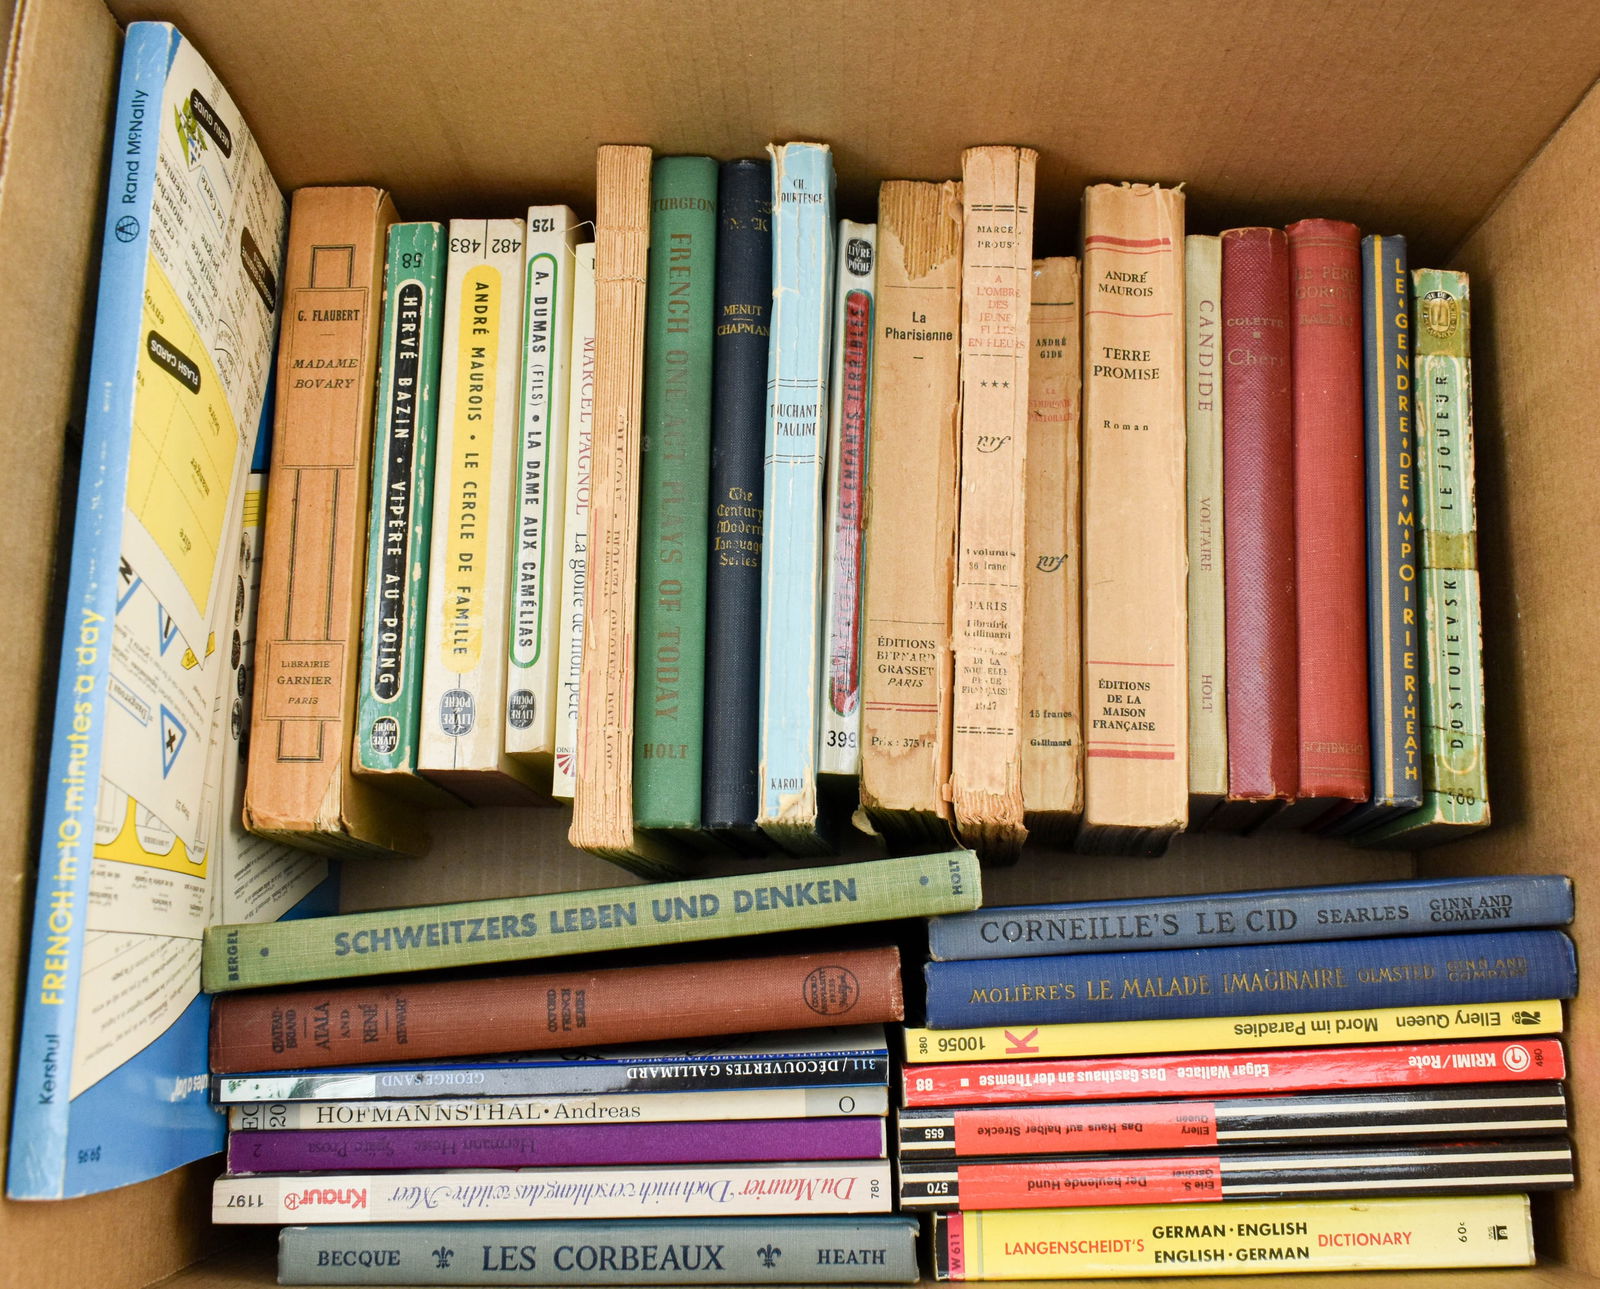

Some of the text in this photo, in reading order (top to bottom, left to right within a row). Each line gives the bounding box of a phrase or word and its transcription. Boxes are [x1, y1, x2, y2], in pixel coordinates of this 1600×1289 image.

[122, 89, 150, 205] Rand McNally
[533, 218, 556, 232] 125
[450, 238, 482, 253] 483
[491, 238, 522, 253] 482
[402, 252, 424, 269] 58
[1105, 270, 1148, 284] ANDRÉ
[1098, 283, 1154, 297] MAUROIS
[298, 309, 360, 323] G. FLAUBERT
[723, 304, 763, 317] MENUT
[912, 311, 927, 324] La
[717, 324, 770, 337] CHAPMAN
[1227, 316, 1285, 329] COLETTE
[885, 327, 953, 342] Pharisienne
[1035, 336, 1067, 347] ANDRÉ
[150, 338, 199, 386] FLASH CARDS
[1040, 350, 1063, 360] GIDE
[1102, 346, 1151, 362] TERRE
[1198, 299, 1215, 412] CANDIDE
[292, 358, 358, 370] MADAME
[1093, 365, 1160, 381] PROMISE
[293, 378, 355, 390] BOVARY
[1104, 420, 1149, 432] Roman
[1435, 376, 1451, 473] JOUEUR
[452, 281, 490, 655] ANDRÉ MAUROIS LE CERCLE DE FAMILLE
[518, 271, 550, 648] A. DUMAS (FILS) LA DAME AUX CAMÉLIAS
[653, 233, 692, 720] FRENCH ONE-ACT PLAYS OF TODAY
[379, 296, 419, 684] HERVÉ BAZIN VIPÈRE AU POING
[1440, 486, 1453, 511] LE
[1394, 257, 1418, 780] LE GENDRE DE M POIRIER HEATH
[1199, 497, 1212, 572] VOLTAIRE
[77, 608, 106, 667] day
[877, 635, 936, 650] ÉDITIONS
[281, 659, 330, 669] LIBRAIRIE
[878, 664, 935, 677] GRASSET
[76, 674, 94, 692] a
[277, 674, 332, 686] GARNIER
[887, 677, 924, 688] PARIS
[1098, 677, 1151, 691] ÉDITIONS
[287, 697, 319, 705] PARIS
[1107, 694, 1142, 705] DE LA
[1201, 674, 1213, 713] HOLT
[1103, 706, 1146, 718] MAISON
[1092, 718, 1156, 733] FRANÇAISE
[62, 700, 94, 812] minutes
[642, 743, 689, 760] HOLT
[53, 857, 77, 882] in
[948, 859, 961, 895] HOLT
[1429, 895, 1513, 911] GINN AND
[334, 877, 857, 956] SCHWEITZERS LEBEN UND DENKEN
[1430, 907, 1514, 923] COMPANY
[980, 905, 1409, 944] CORNEILLE'S LE CID SEARLES
[41, 891, 75, 1005] FRENCH
[228, 929, 239, 982] BERGEL
[968, 963, 1435, 1004] MOLIÈRE'S LE MALADE IMAGINAIRE OLMSTED
[546, 989, 557, 1033] OXFORD
[561, 988, 572, 1033] FRENCH
[313, 1001, 331, 1051] ATALA
[340, 1009, 351, 1038] AND
[359, 1003, 378, 1044] RENÉ
[1234, 1011, 1501, 1038] Ellery Queen Mord im Paradies
[918, 1036, 928, 1055] 380
[938, 1036, 987, 1052] 10056
[38, 1034, 60, 1105] Kershul
[626, 1058, 876, 1080] 311 DÉCOUVERTES GALLIMARD
[979, 1063, 1269, 1088] Edgar Wallace Das Gasthaus an der Themse
[382, 1071, 485, 1087] GEORGE SAND
[916, 1078, 934, 1091] 88
[316, 1101, 641, 1124] HOFMANNSTHAL Andreas
[1175, 1114, 1209, 1125] Queen
[924, 1128, 945, 1139] 655
[977, 1121, 1143, 1137] Das Haus auf halber Strecke
[1181, 1125, 1210, 1136] Ellery
[739, 1177, 858, 1202] Du Maurier
[870, 1179, 880, 1200] 780
[926, 1182, 949, 1195] 570
[1027, 1175, 1147, 1191] Der heulende Hund
[227, 1194, 264, 1208] 1197
[299, 1188, 367, 1208] Knaur
[1152, 1222, 1308, 1239] GERMAN ENGLISH
[1318, 1231, 1413, 1247] DICTIONARY
[1005, 1238, 1145, 1256] LANGENSCHEIDT'S
[1154, 1246, 1310, 1264] ENGLISH GERMAN
[317, 1245, 886, 1271] BECQUE LES CORBEAUX HEATH
